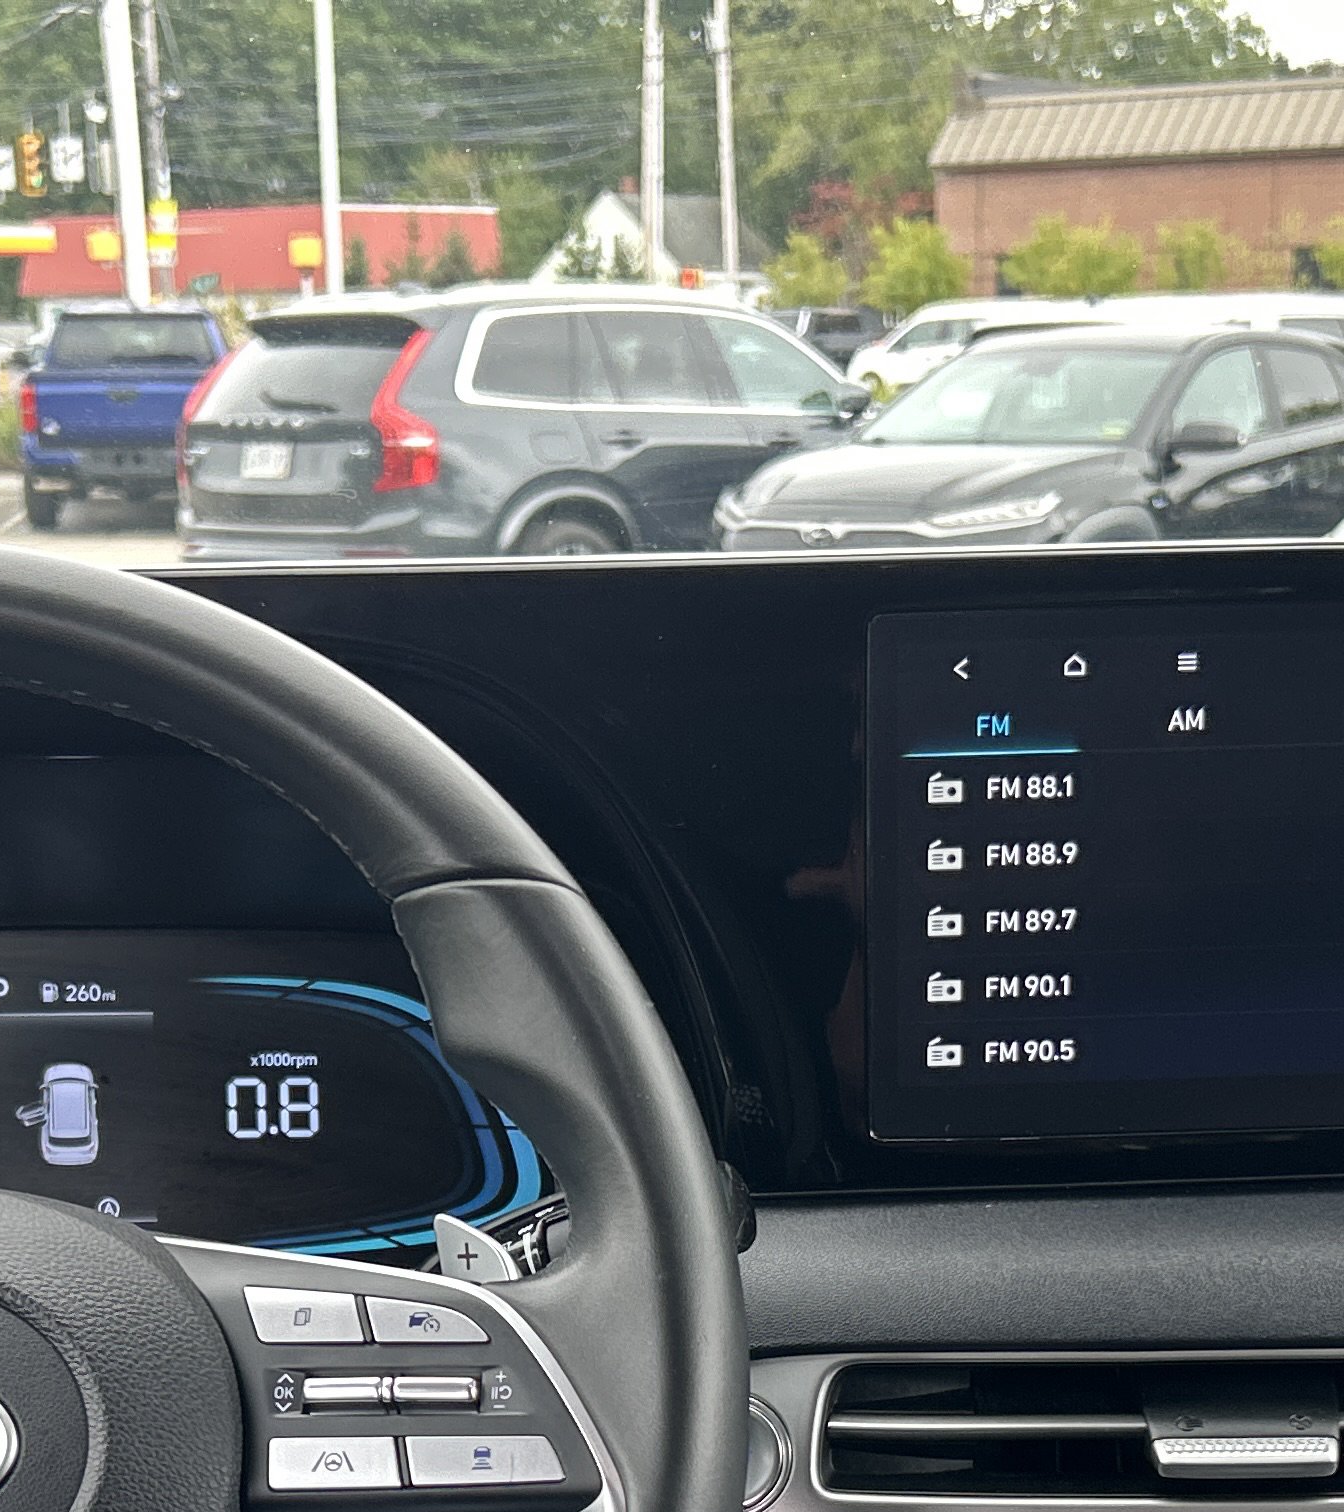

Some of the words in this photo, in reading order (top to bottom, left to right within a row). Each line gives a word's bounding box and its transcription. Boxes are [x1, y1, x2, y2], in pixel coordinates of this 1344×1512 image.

[977, 715, 1009, 736] FM
[1168, 708, 1204, 731] AM
[988, 776, 1019, 799] FM
[1027, 775, 1072, 798] 88.1
[987, 844, 1019, 866] FM
[1026, 842, 1077, 865] 88.9
[987, 911, 1019, 932] FM
[1026, 909, 1076, 931] 89.7
[986, 977, 1017, 998] FM
[1025, 975, 1070, 996] 90.1
[251, 1053, 317, 1068] x1000rpm
[985, 1041, 1017, 1062] FM
[1024, 1040, 1075, 1061] 90.5
[227, 1077, 319, 1138] 0.8
[274, 1386, 294, 1399] OK
